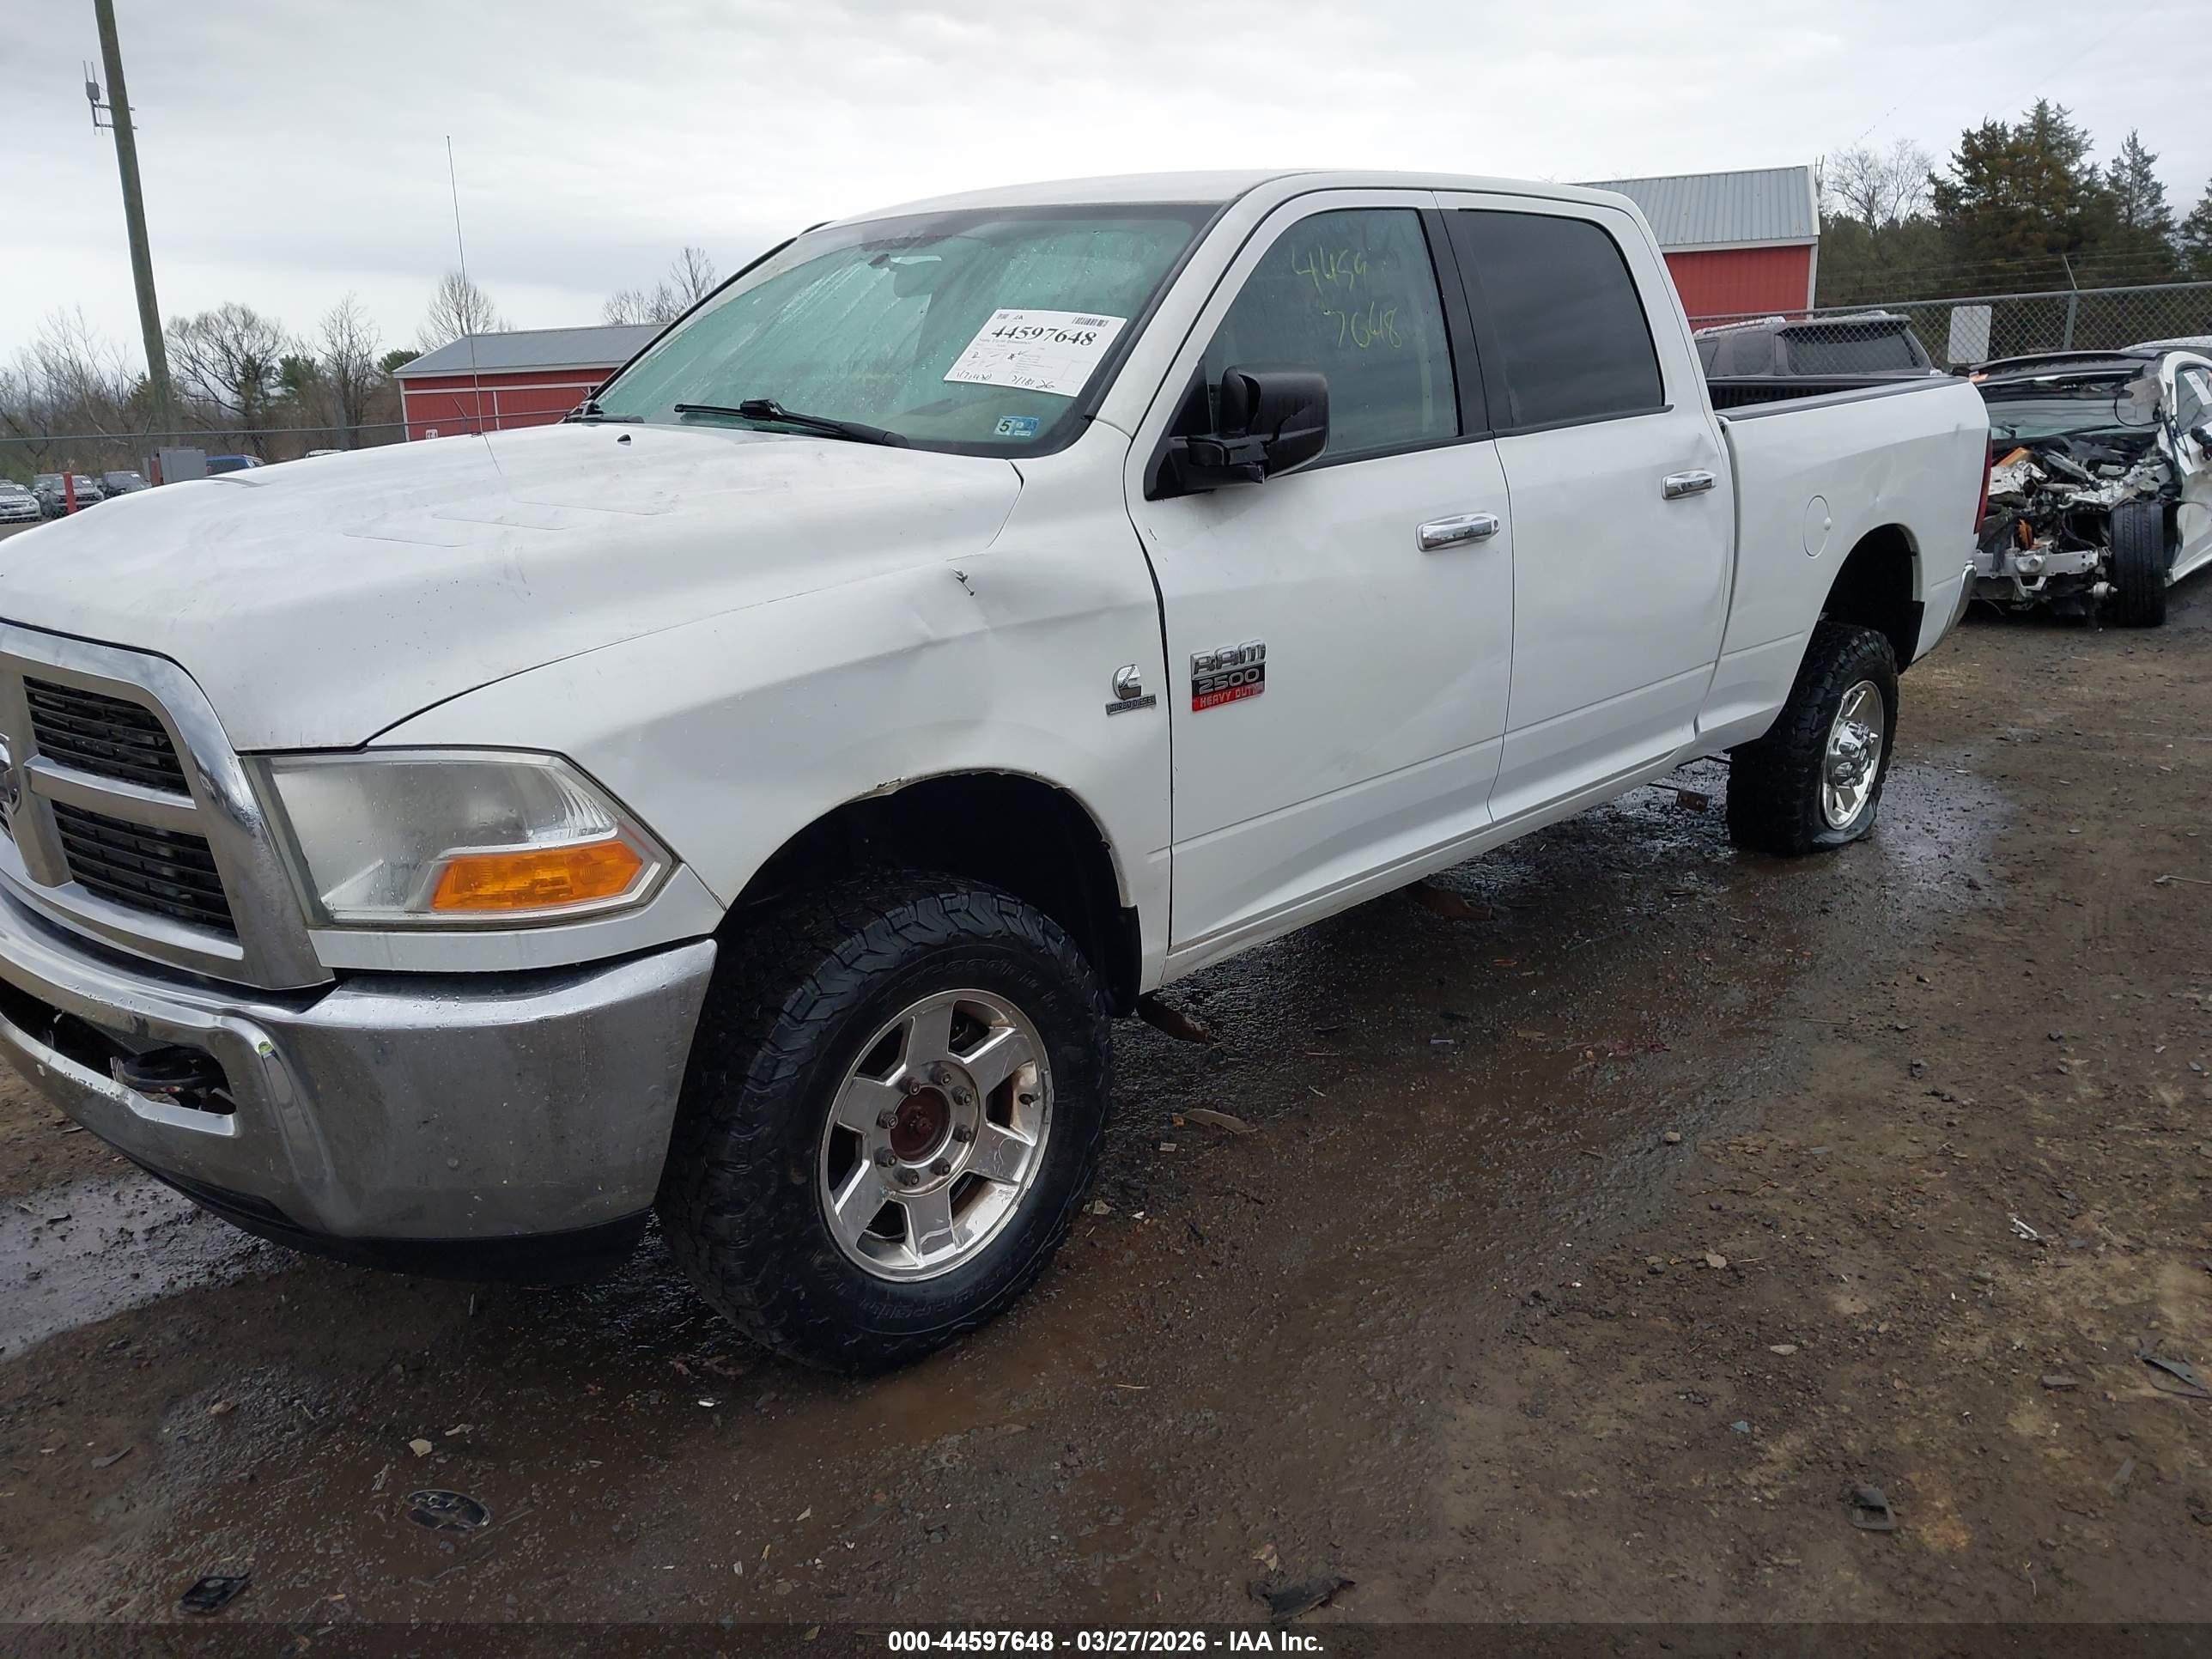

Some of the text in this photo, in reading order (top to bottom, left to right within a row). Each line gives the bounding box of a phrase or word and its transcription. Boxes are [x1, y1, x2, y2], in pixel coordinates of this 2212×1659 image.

[1291, 246, 1368, 296] 4459
[991, 325, 1097, 346] 44597648
[1323, 302, 1402, 349] 7648
[999, 420, 1012, 432] 5
[1190, 640, 1267, 677] RAM
[1199, 668, 1260, 695] 2500
[1109, 696, 1155, 712] TURBO DIESEL
[1200, 682, 1264, 708] HEAVY DUTY
